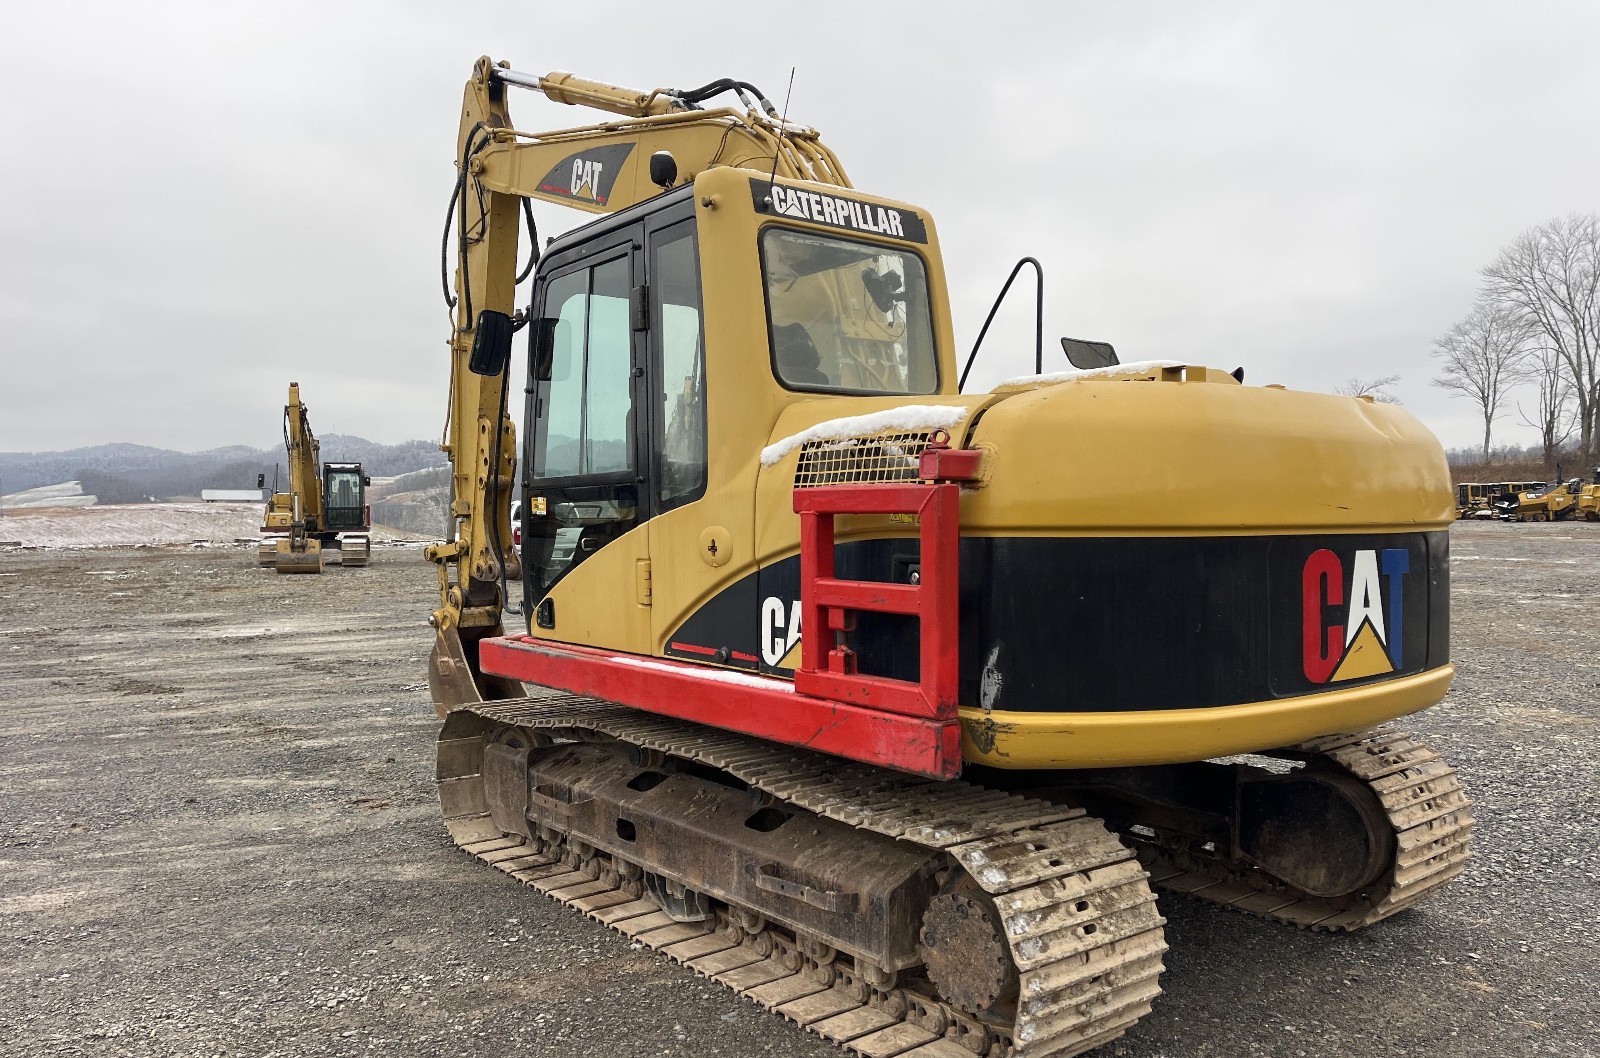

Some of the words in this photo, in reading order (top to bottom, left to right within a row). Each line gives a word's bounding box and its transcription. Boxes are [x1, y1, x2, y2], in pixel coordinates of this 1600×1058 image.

[571, 159, 602, 200] CAT
[771, 186, 904, 236] CATERPILLAR
[761, 596, 802, 667] CA
[1302, 548, 1409, 684] CAT
